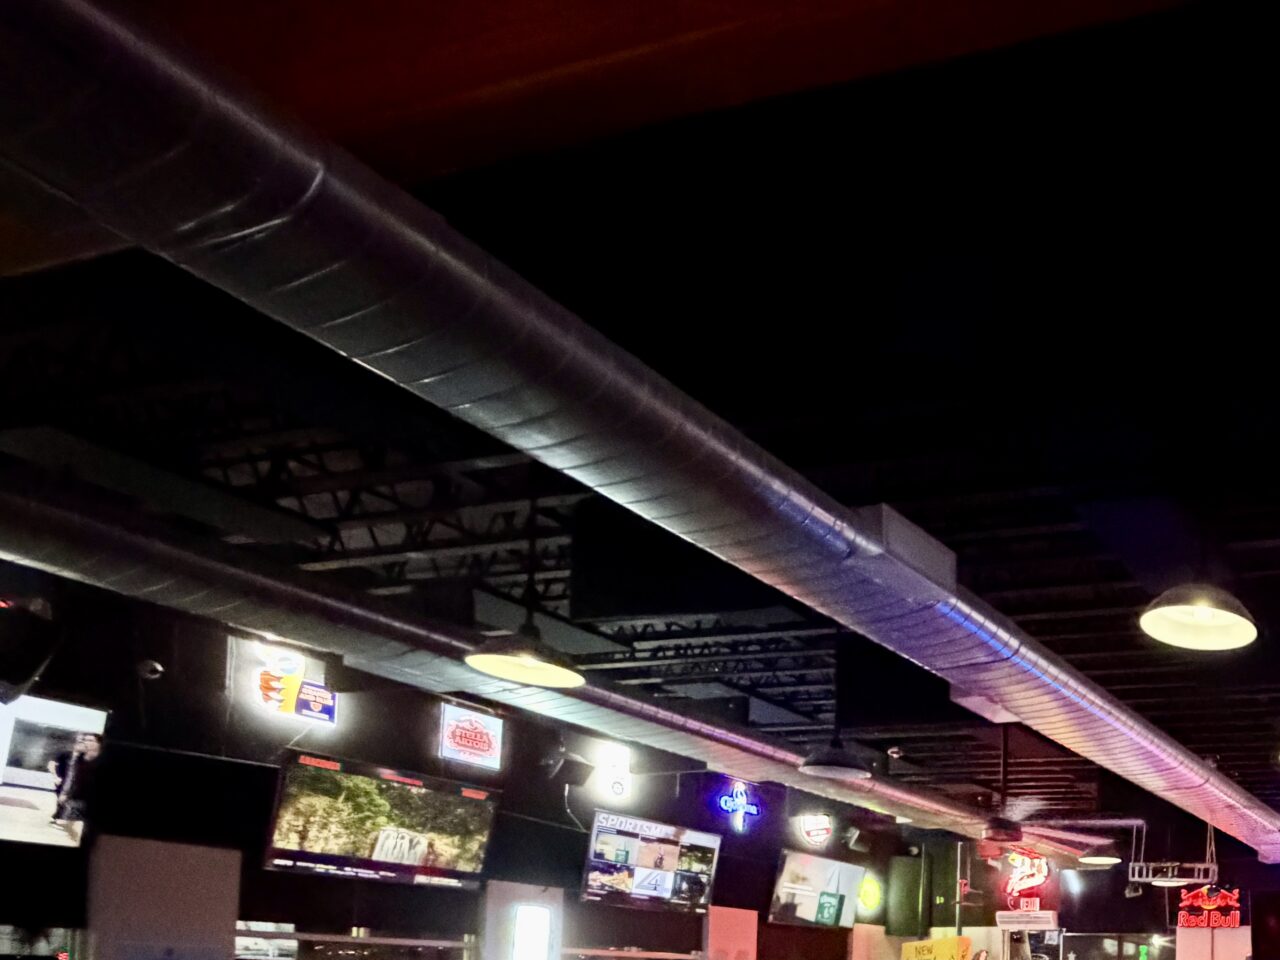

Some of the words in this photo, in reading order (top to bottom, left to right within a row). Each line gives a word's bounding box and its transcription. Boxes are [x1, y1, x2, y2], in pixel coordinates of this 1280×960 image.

[455, 728, 490, 744] STELLA
[1178, 911, 1208, 928] Red
[1210, 911, 1240, 928] Bull
